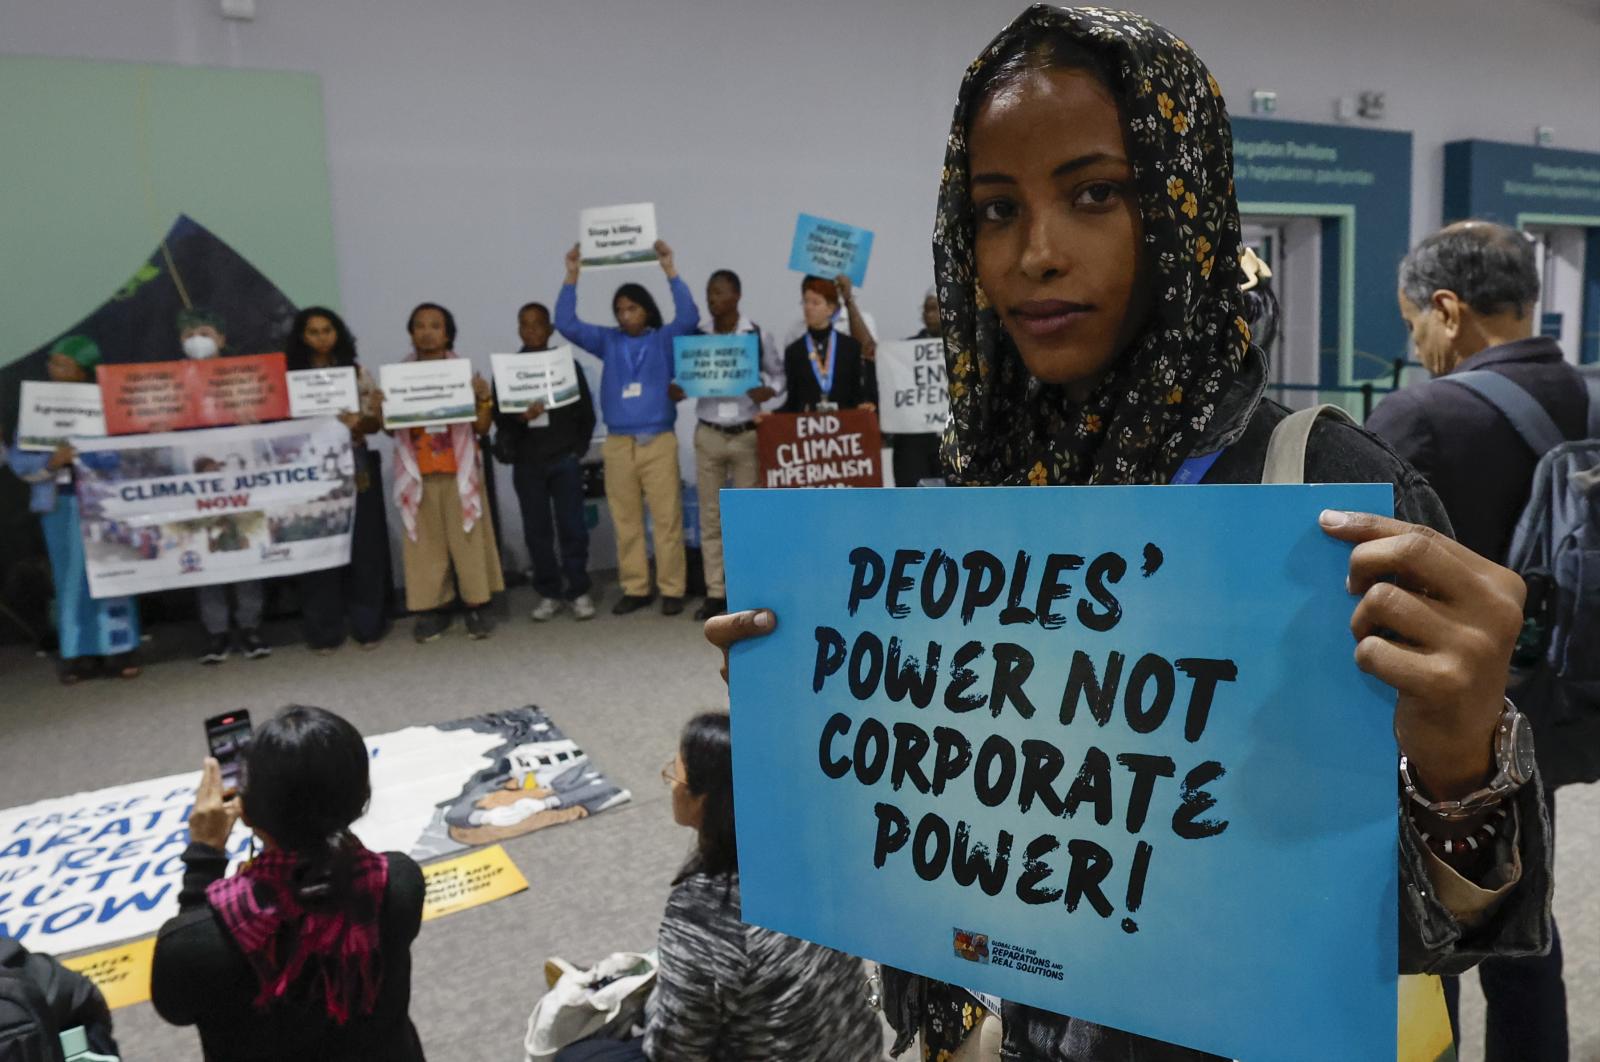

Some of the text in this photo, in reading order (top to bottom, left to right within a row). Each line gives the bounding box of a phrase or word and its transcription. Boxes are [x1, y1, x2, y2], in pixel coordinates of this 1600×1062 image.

[588, 224, 642, 237] Stop killing
[515, 370, 555, 380] Climae
[796, 415, 840, 438] END
[776, 433, 863, 468] CLIMATE
[121, 466, 320, 502] CLIMATE JUSTICE
[767, 457, 873, 488] IMPERIALISM
[196, 494, 251, 512] NOW
[812, 625, 1237, 742] POWER NOT
[818, 712, 1230, 839] CORPORATE
[13, 795, 149, 834] FALSE
[873, 801, 1152, 934] POWER!
[0, 883, 172, 942] NOW
[991, 940, 1011, 950] GLOBAL
[1012, 945, 1024, 953] CALL
[991, 947, 1051, 968] REPARATIONS
[991, 956, 1064, 981] REAL SOLUTIONS
